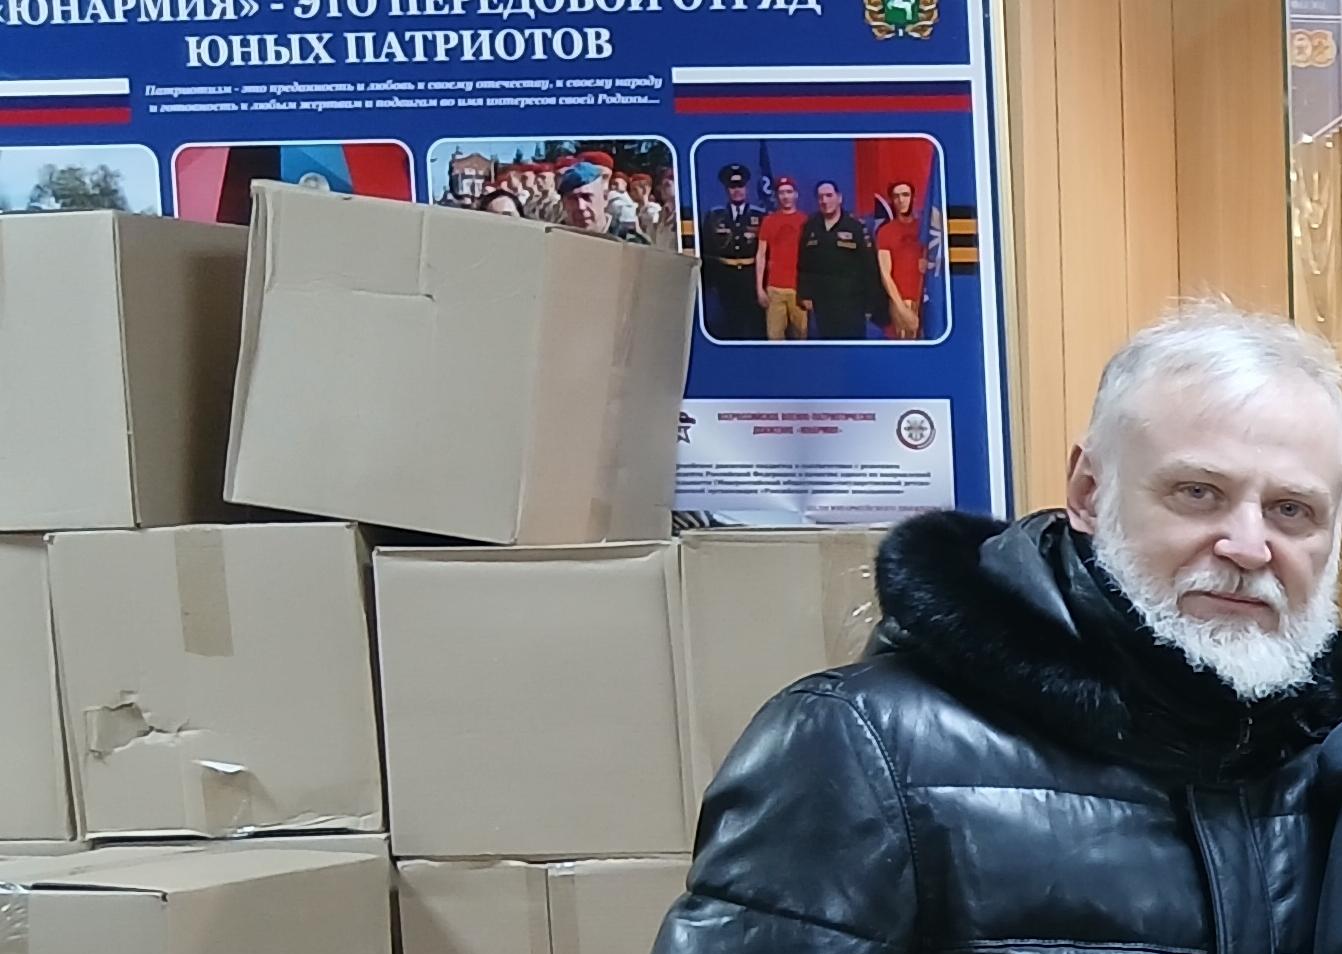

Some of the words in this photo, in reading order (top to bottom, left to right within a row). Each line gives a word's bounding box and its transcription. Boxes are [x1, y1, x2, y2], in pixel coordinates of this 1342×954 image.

[0, 0, 258, 25] ЮНАРМИЯ»
[185, 33, 336, 67] ЮНЫХ
[344, 27, 613, 64] ПАТРИОТОВ
